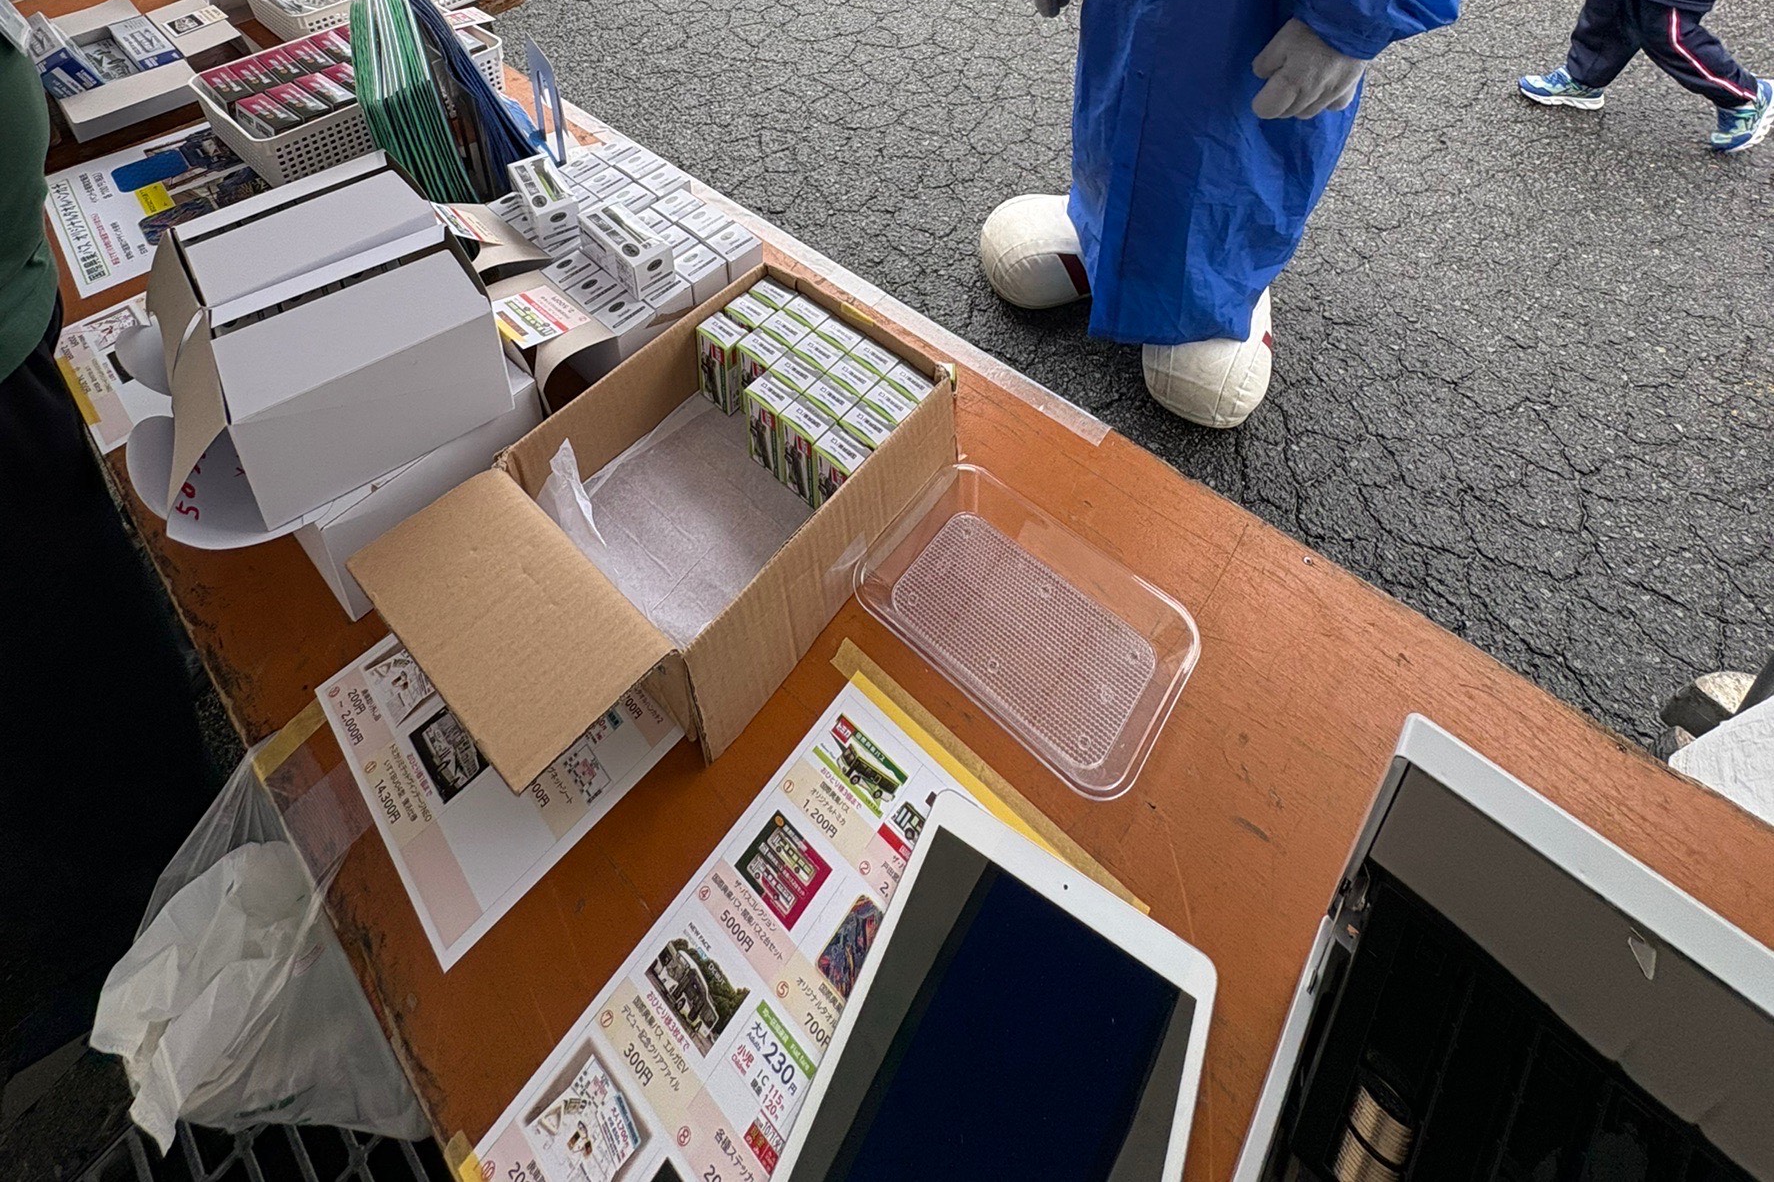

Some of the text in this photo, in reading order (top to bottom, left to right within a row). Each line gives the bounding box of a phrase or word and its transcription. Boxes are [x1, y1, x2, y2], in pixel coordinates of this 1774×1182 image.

[374, 779, 401, 825] 14,300円
[802, 798, 838, 839] 1,200円
[810, 787, 846, 826] オリジナルトミカ
[719, 909, 755, 953] 5000円
[620, 1004, 680, 1092] デビュー記念クリアファイル
[623, 1042, 654, 1087] 300円
